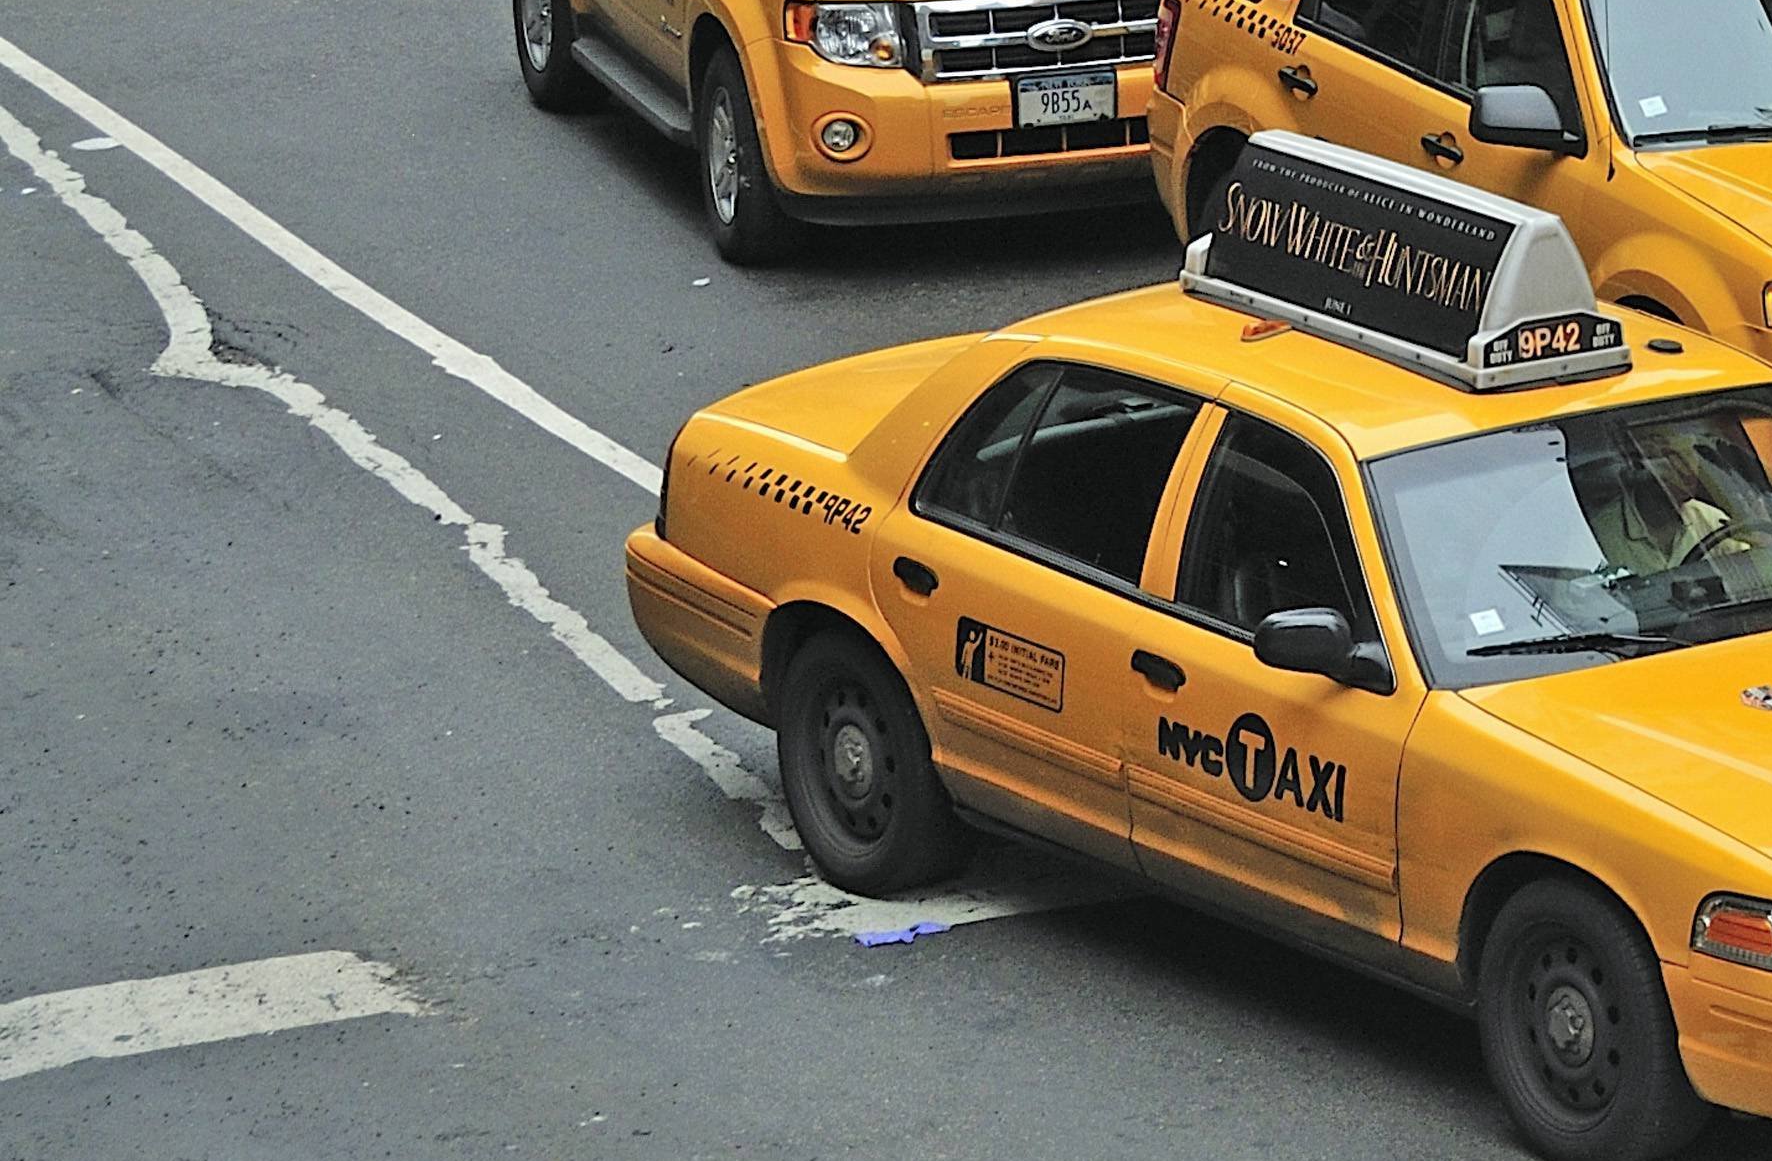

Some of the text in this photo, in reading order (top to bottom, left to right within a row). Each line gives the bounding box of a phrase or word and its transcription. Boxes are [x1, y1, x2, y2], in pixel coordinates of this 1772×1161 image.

[1218, 181, 1286, 247] SNOW
[1253, 158, 1276, 172] FROM
[1280, 167, 1297, 180] THE
[1299, 173, 1345, 194] PRODUCER
[1363, 189, 1396, 211] ALICE
[1400, 201, 1413, 214] IN
[1418, 208, 1496, 241] WONDERLAND
[1283, 200, 1357, 273] WHITE
[1356, 234, 1374, 261] &
[1364, 227, 1493, 313] HUNTSMAN
[1324, 296, 1345, 314] JUNE
[1490, 350, 1513, 364] DUTY
[1519, 322, 1580, 359] 9P42
[1592, 334, 1615, 347] DUTY
[823, 494, 873, 535] 9P42
[1011, 644, 1060, 671] INITIAL FARE
[1158, 712, 1347, 822] NYC TAXI
